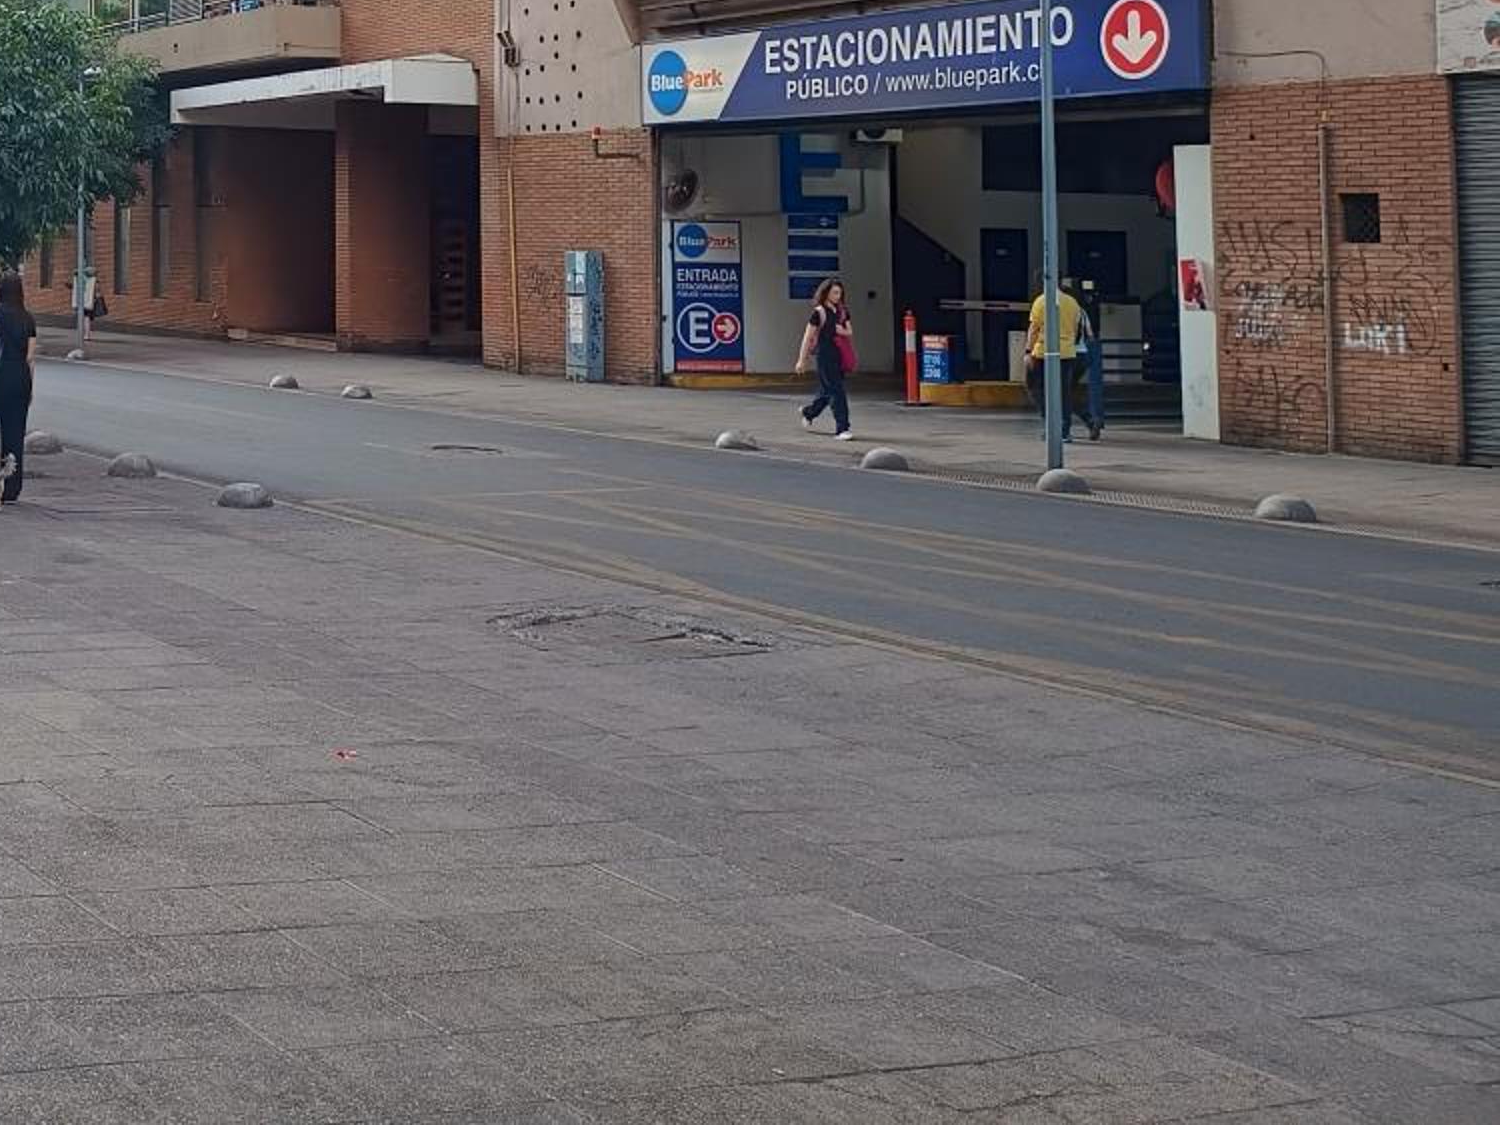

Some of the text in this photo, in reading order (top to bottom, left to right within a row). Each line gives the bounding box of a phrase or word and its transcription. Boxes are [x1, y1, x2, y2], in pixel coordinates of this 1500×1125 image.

[765, 6, 1074, 74] ESTACIONAMIENTO
[651, 68, 724, 92] BluePark
[787, 75, 869, 100] PÚBLICO
[677, 268, 738, 282] ENTRADA
[688, 311, 711, 344] E
